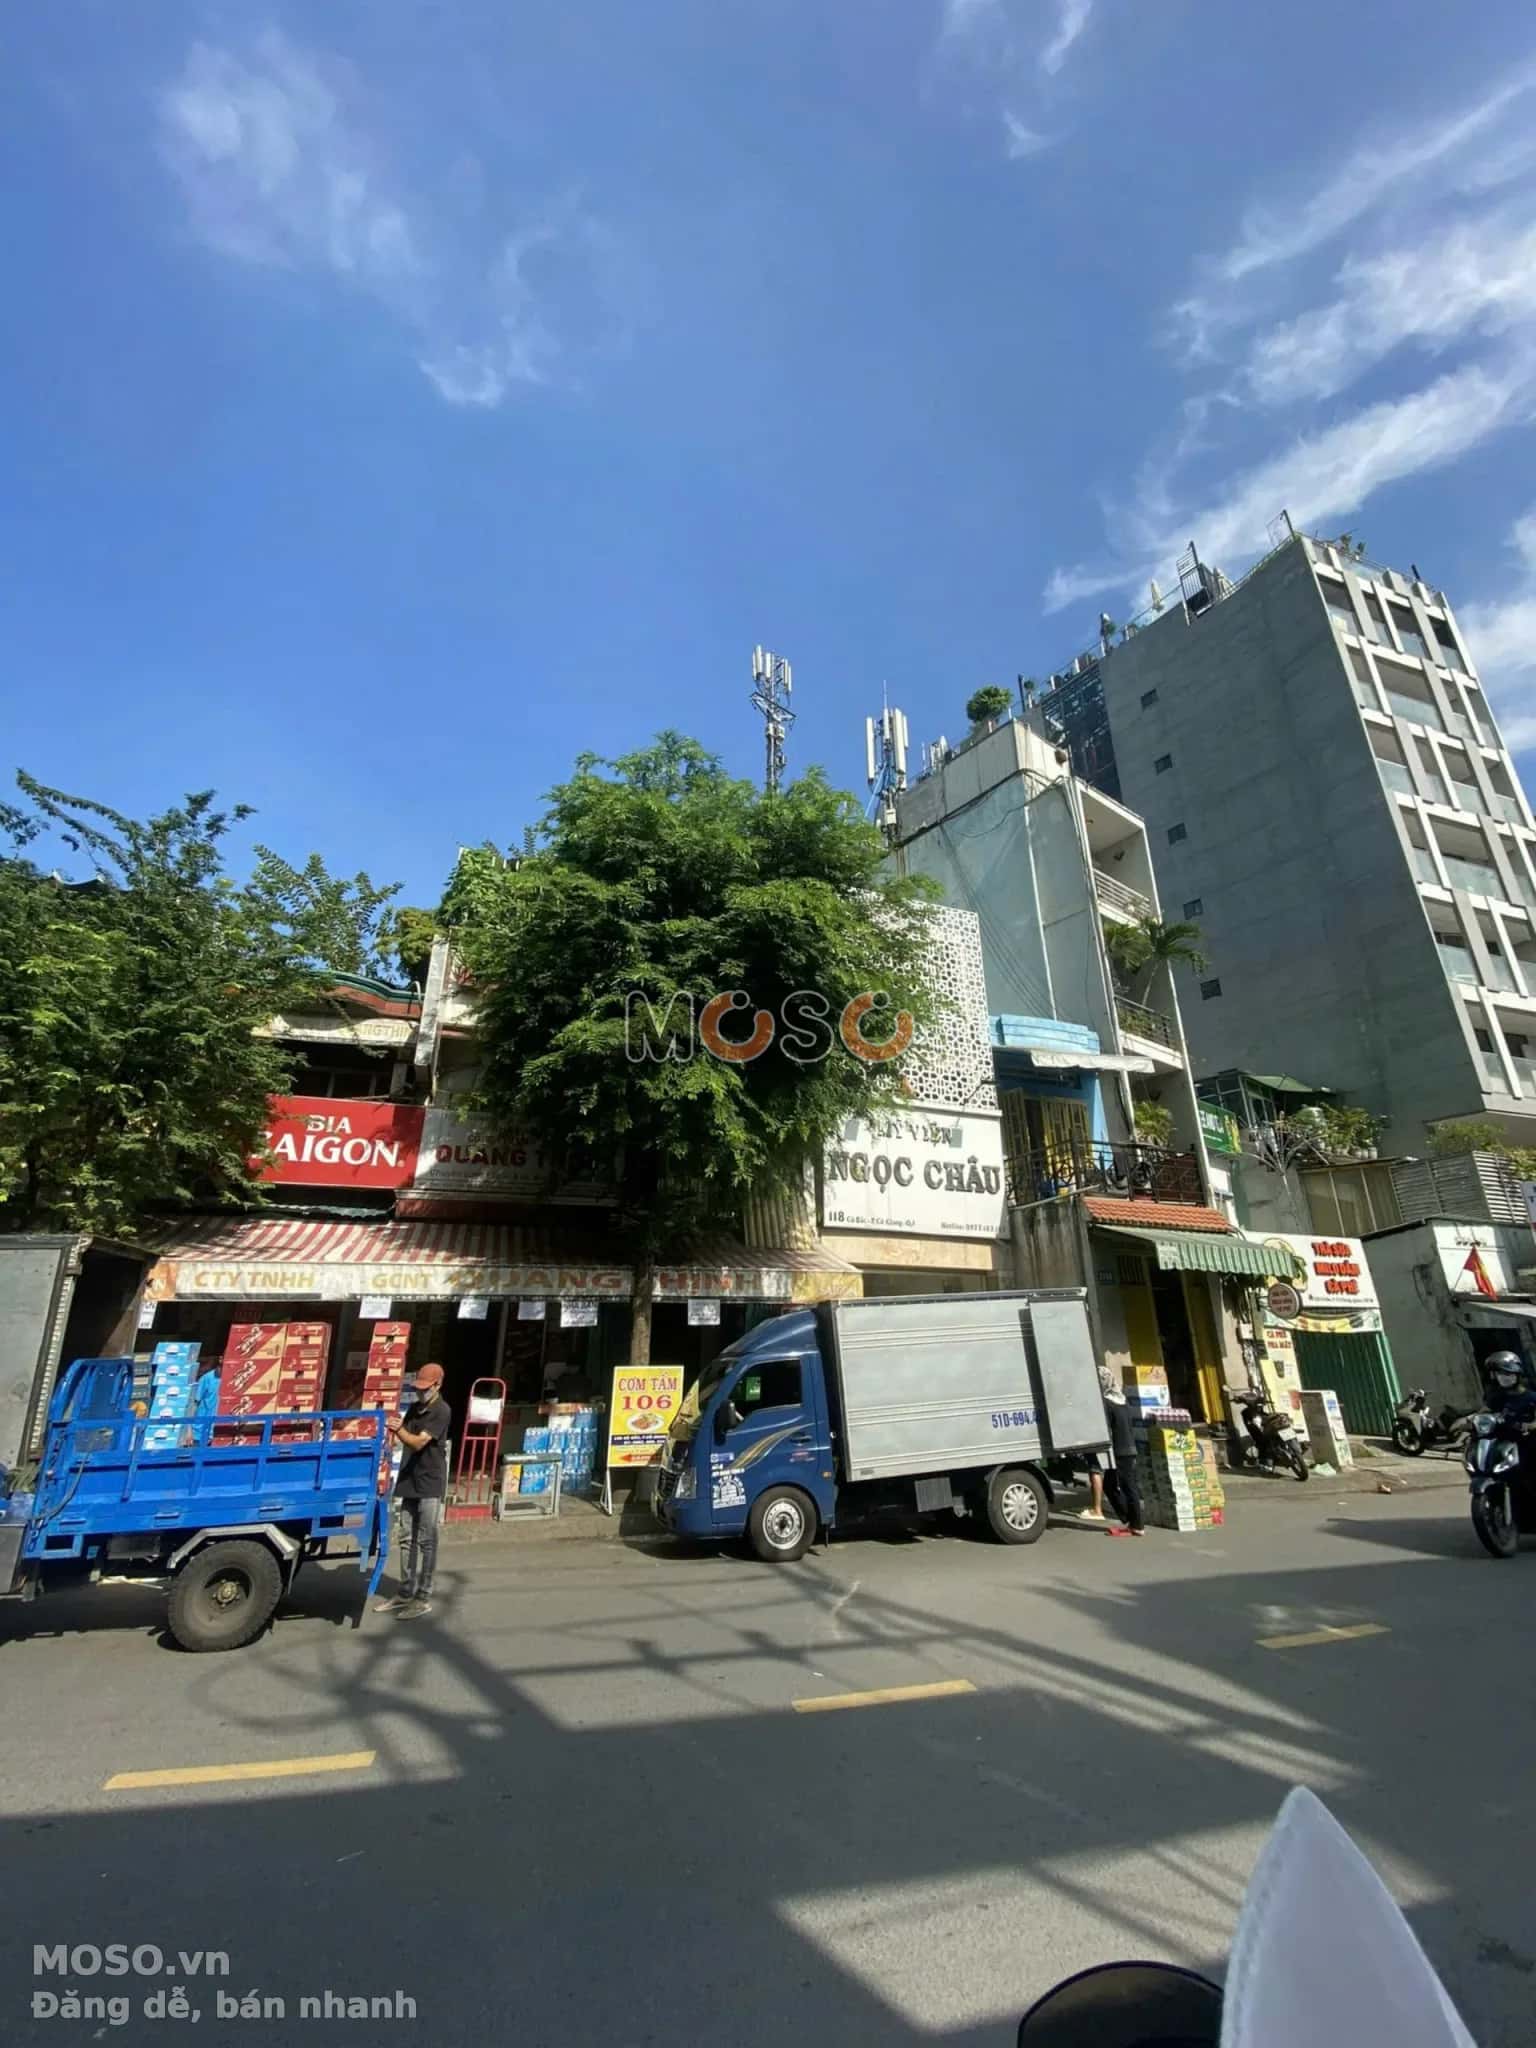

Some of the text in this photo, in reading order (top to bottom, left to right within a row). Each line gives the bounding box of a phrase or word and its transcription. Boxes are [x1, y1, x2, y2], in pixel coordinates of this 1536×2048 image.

[829, 1151, 1001, 1195] NGỌC CHÂU
[829, 1211, 845, 1223] 118
[194, 1271, 241, 1288] CTY
[248, 1271, 316, 1288] TNHH
[618, 1376, 646, 1391] CƠM
[622, 1395, 672, 1410] 106
